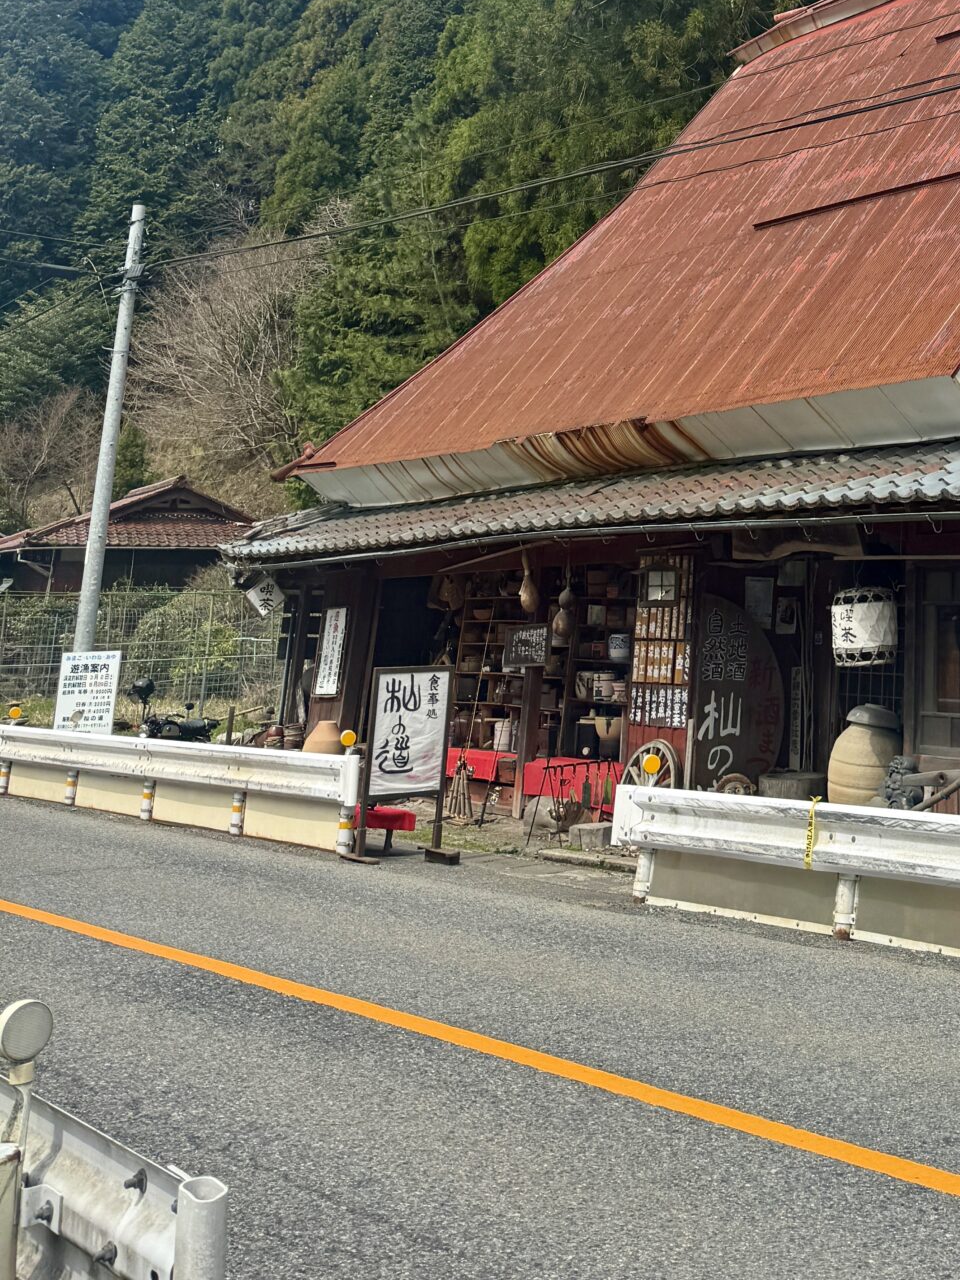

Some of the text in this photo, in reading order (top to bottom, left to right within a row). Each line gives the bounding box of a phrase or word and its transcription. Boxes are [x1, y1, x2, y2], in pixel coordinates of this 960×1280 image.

[260, 582, 274, 611] 喫茶
[69, 663, 110, 674] 遊漁案内
[703, 609, 726, 680] 自然酒
[726, 614, 748, 681] 土地酒
[426, 674, 440, 720] 食事処
[698, 690, 742, 792] 杣の
